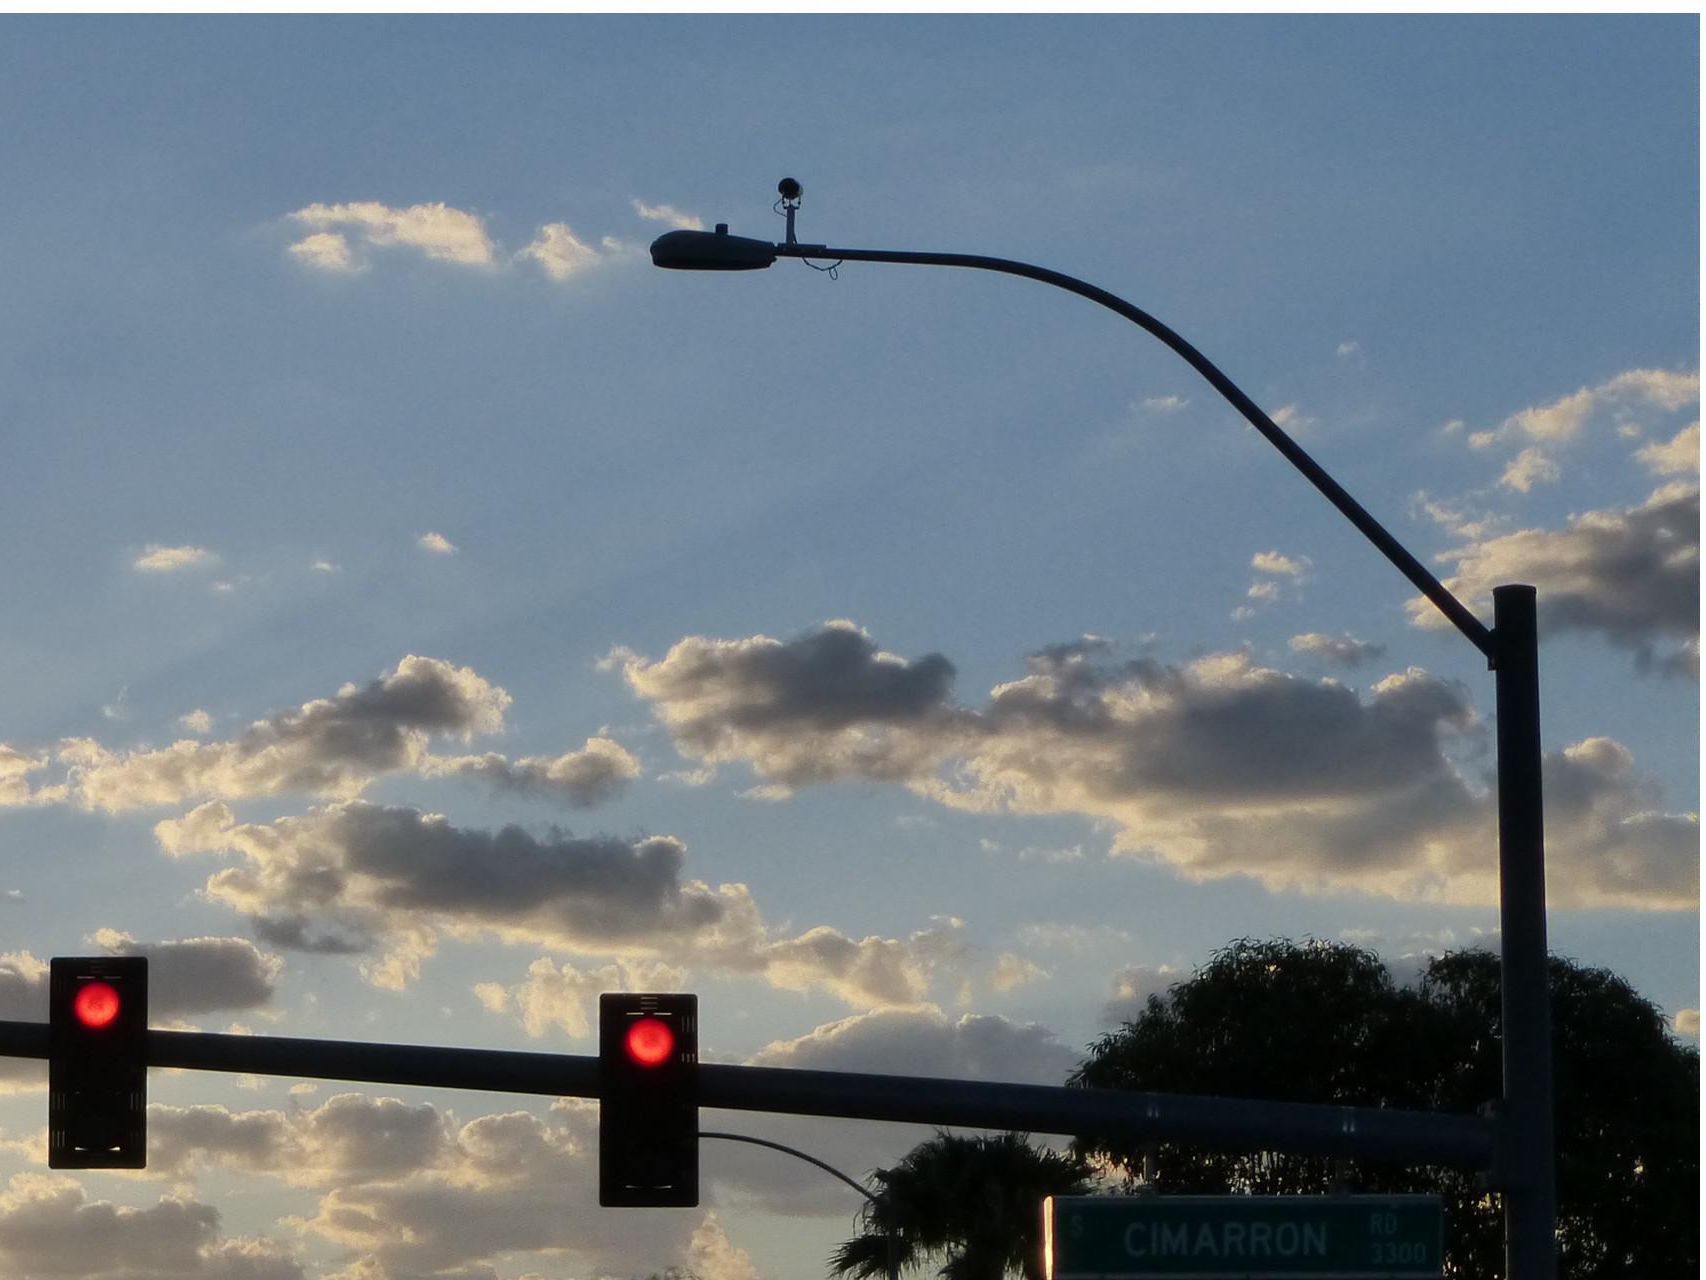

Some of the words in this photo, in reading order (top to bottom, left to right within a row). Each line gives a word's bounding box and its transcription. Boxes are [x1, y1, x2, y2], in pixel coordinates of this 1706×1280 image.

[1070, 1214, 1084, 1238] S
[1123, 1221, 1329, 1257] CIMARRON
[1369, 1213, 1398, 1235] RD
[1370, 1242, 1428, 1265] 3300
